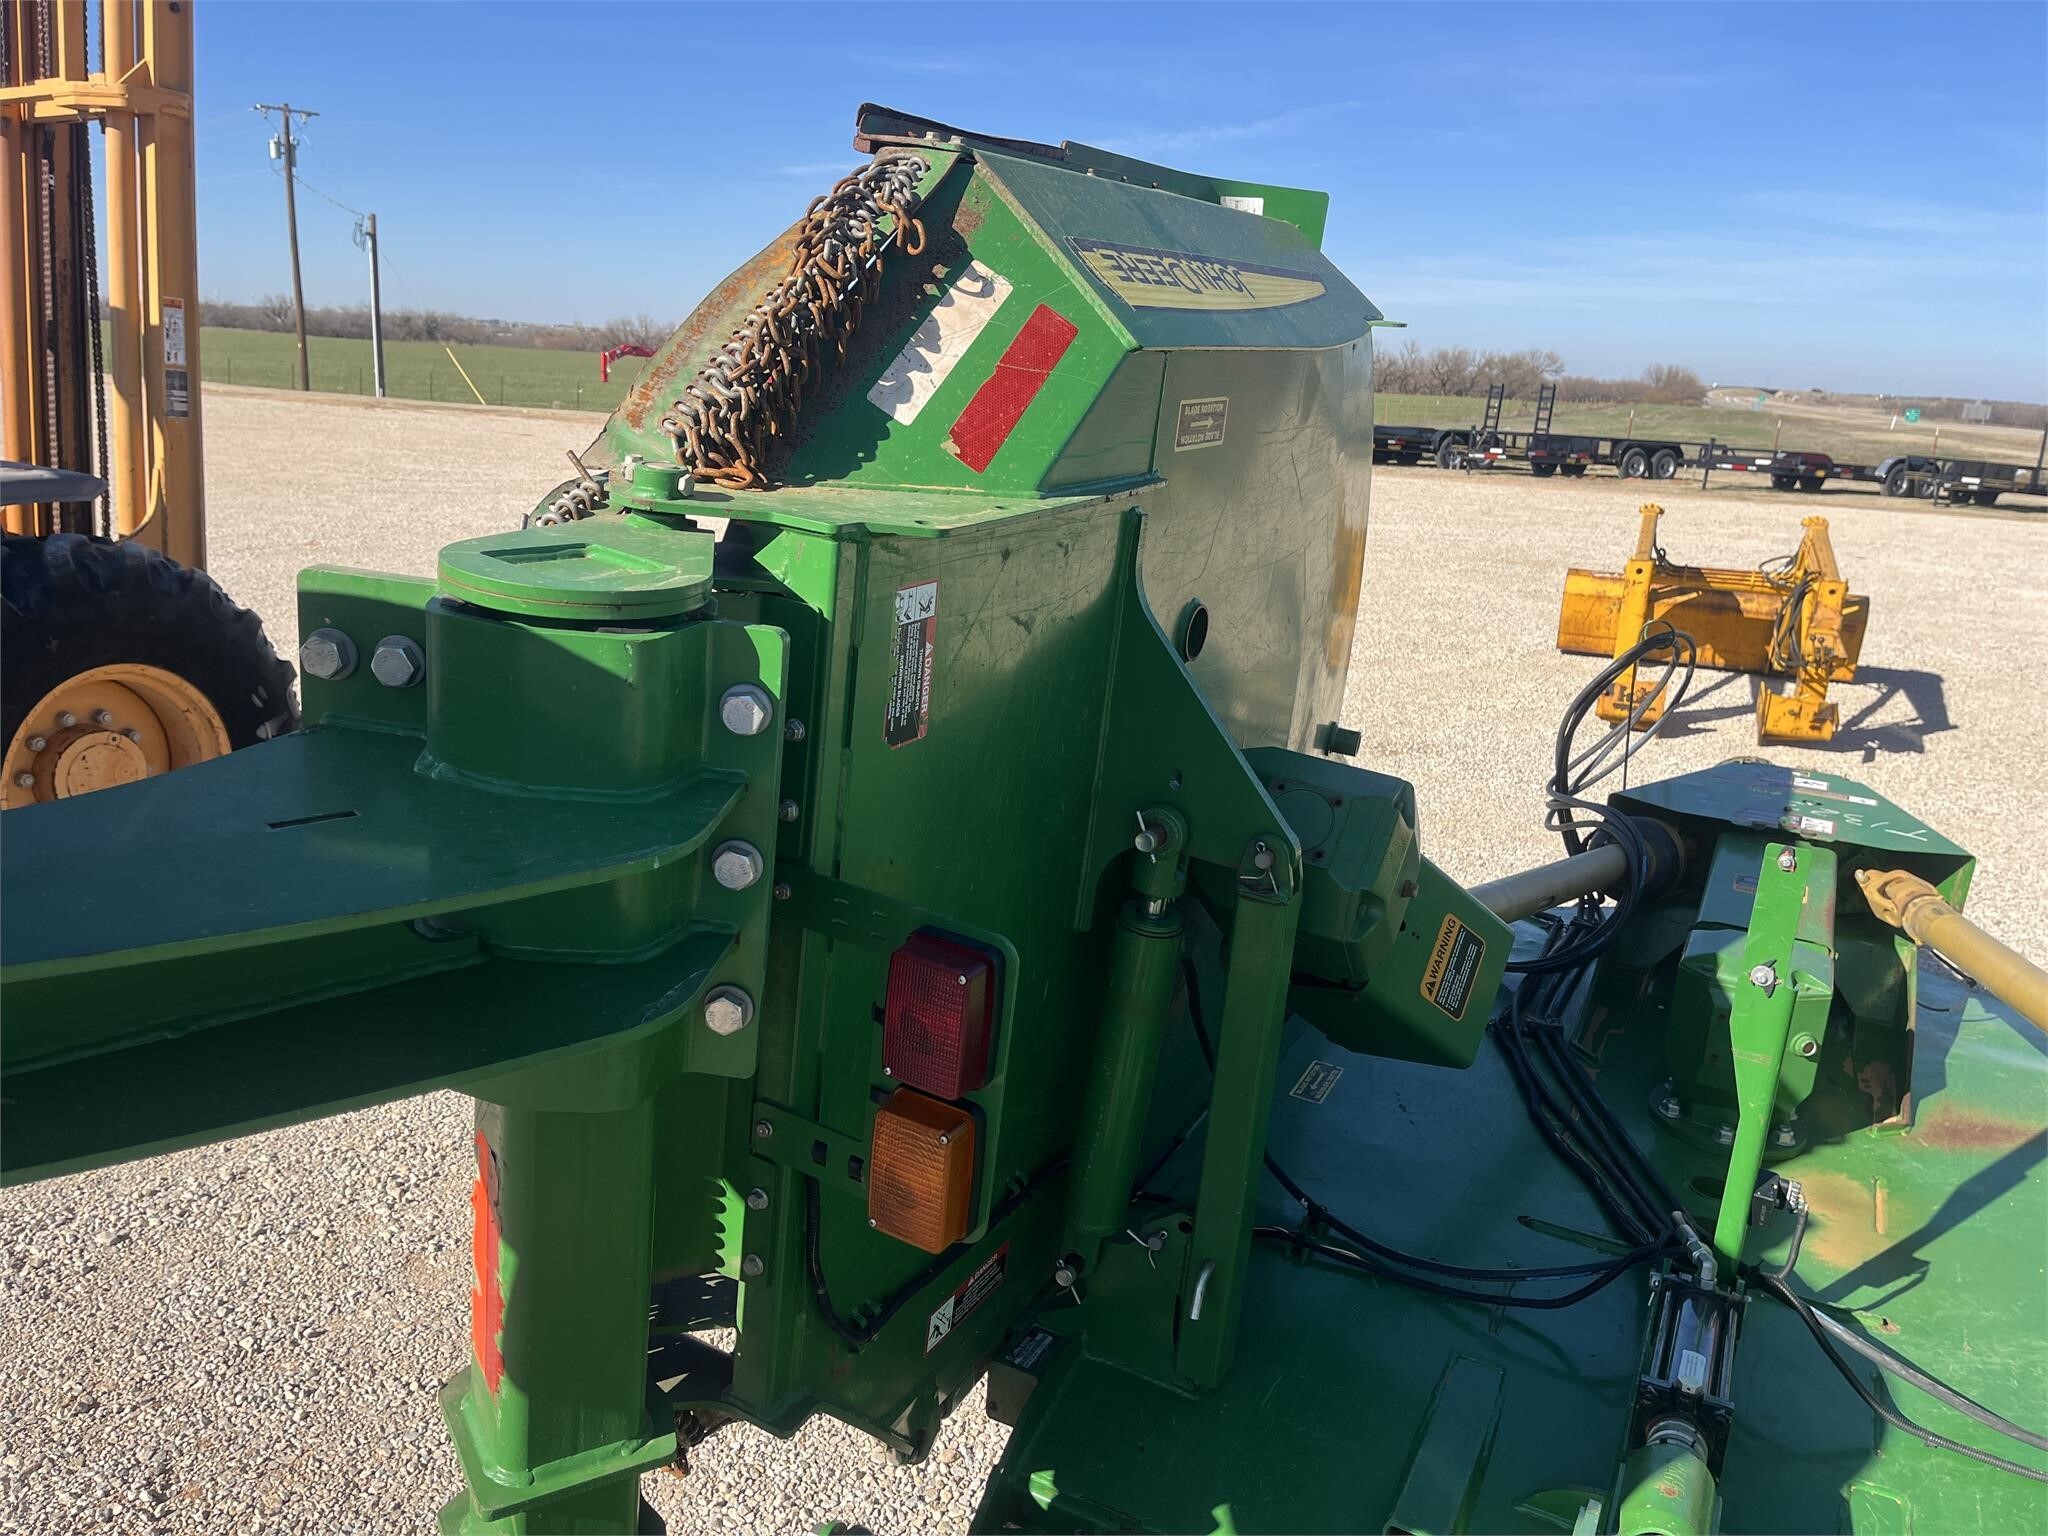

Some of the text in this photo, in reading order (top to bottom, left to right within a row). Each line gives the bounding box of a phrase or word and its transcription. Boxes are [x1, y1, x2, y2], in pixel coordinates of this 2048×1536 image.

[1102, 253, 1256, 300] JOHN DEERE
[1184, 403, 1224, 415] BLADE ROTATION
[920, 656, 931, 713] DANGER
[1429, 918, 1457, 979] WARNING
